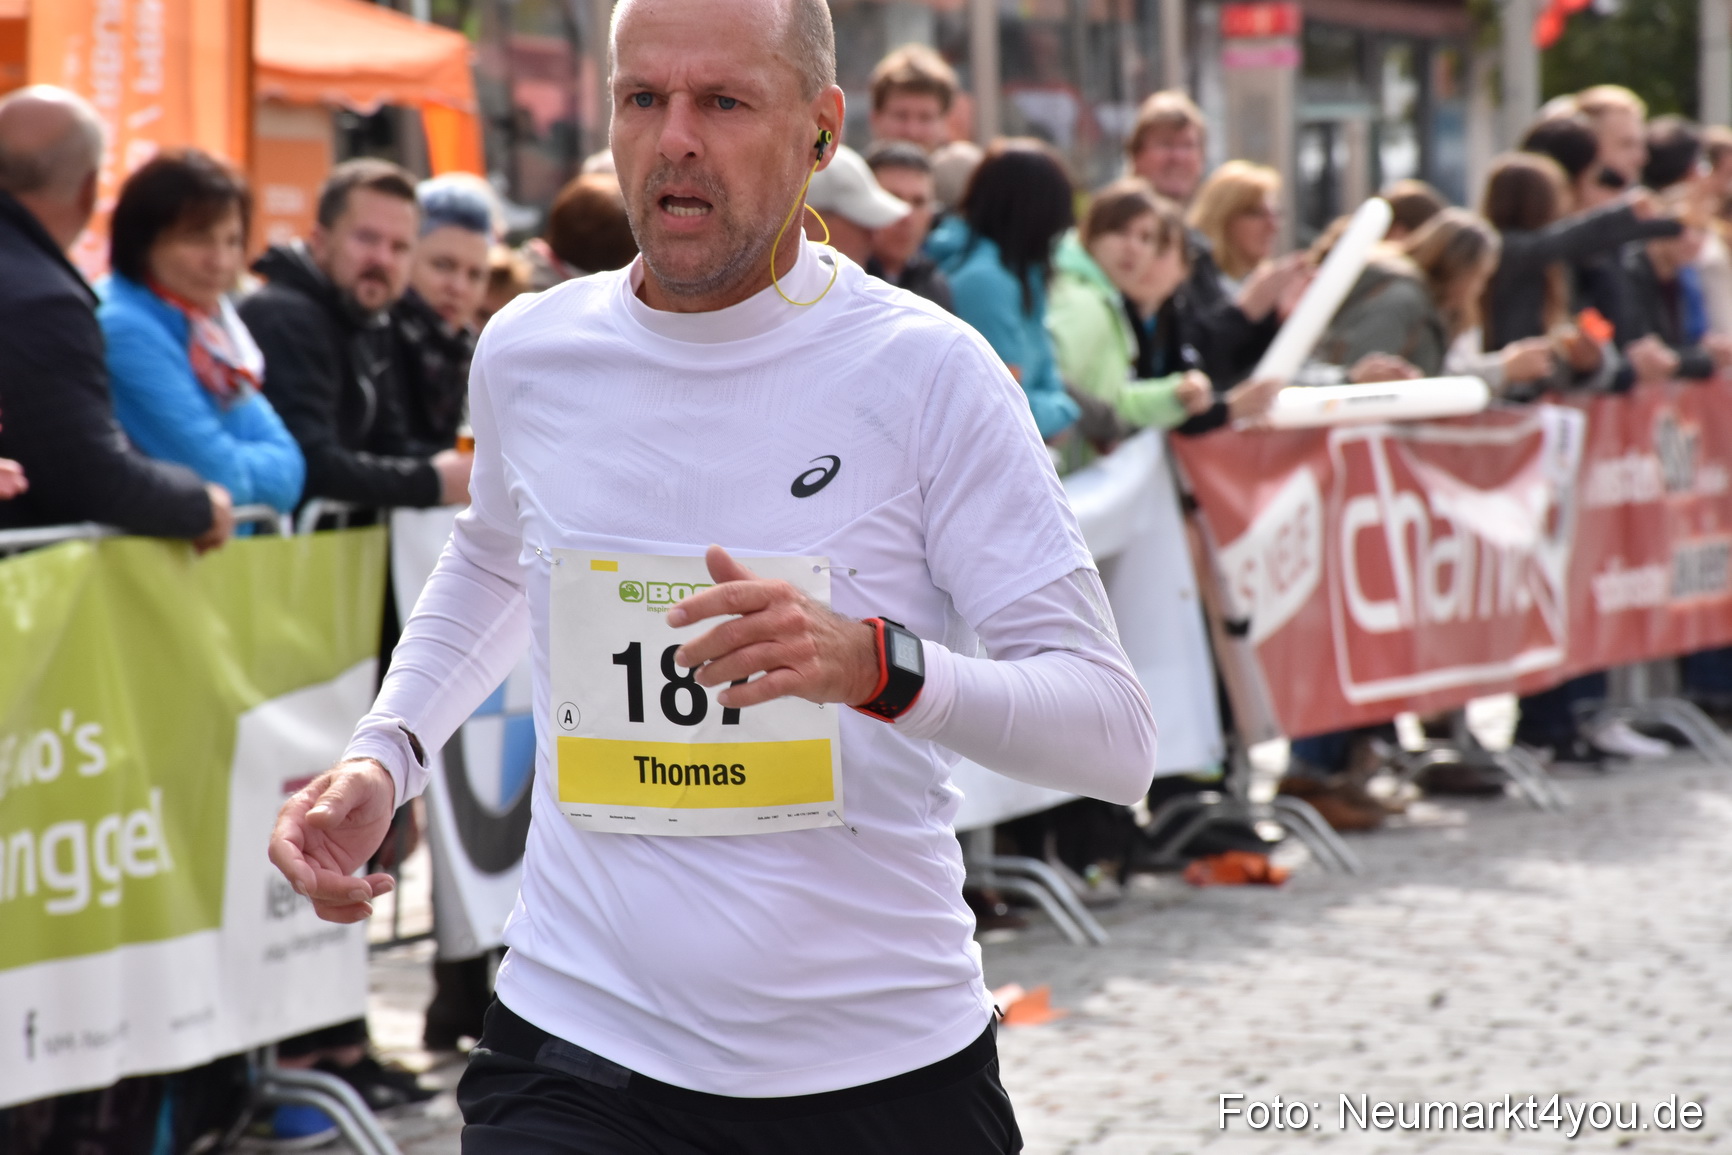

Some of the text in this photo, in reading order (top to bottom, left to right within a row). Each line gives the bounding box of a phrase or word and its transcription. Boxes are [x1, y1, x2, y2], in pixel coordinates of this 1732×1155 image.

[647, 582, 716, 604] BO
[563, 709, 573, 724] A
[633, 755, 746, 786] Thomas
